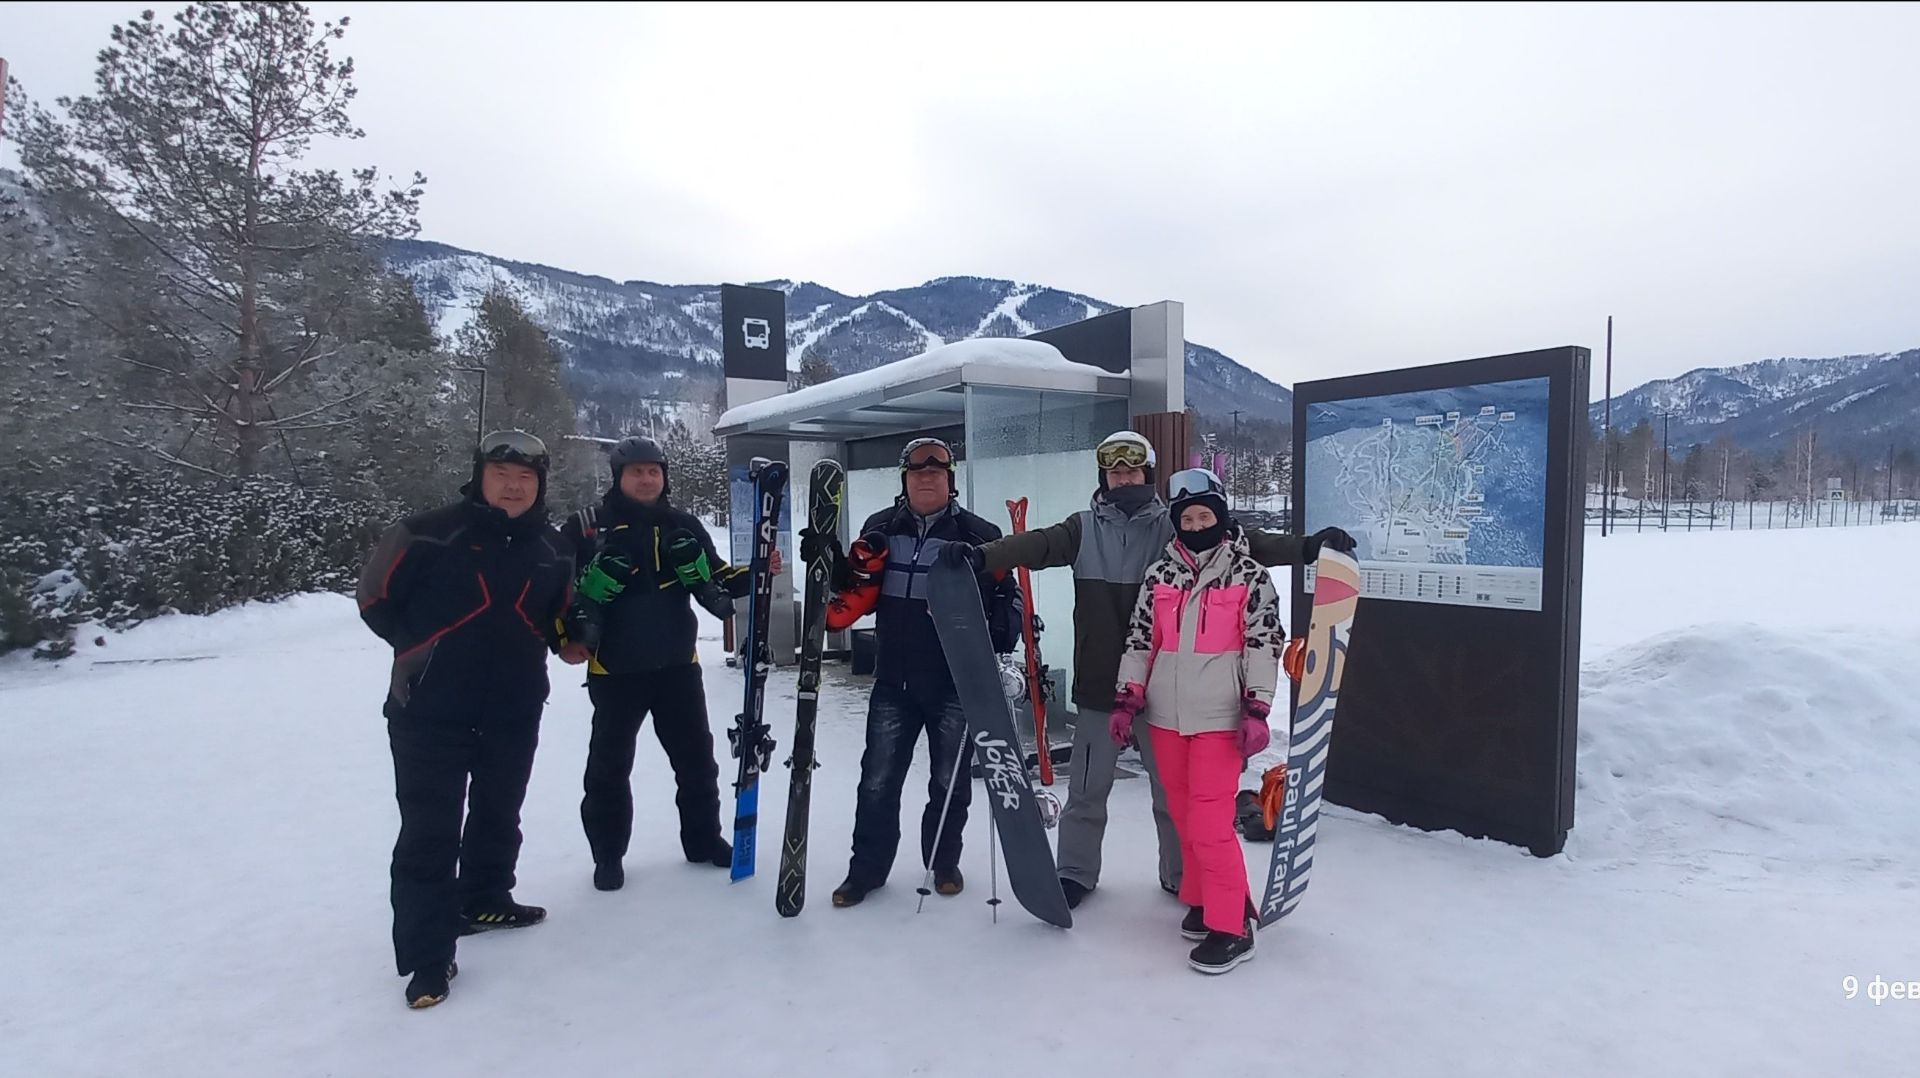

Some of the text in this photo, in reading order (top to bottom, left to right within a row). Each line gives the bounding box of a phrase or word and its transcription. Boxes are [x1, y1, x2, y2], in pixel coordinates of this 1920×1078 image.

[974, 730, 1020, 811] JOKER
[1004, 747, 1028, 790] THE
[1263, 767, 1302, 917] paul frank
